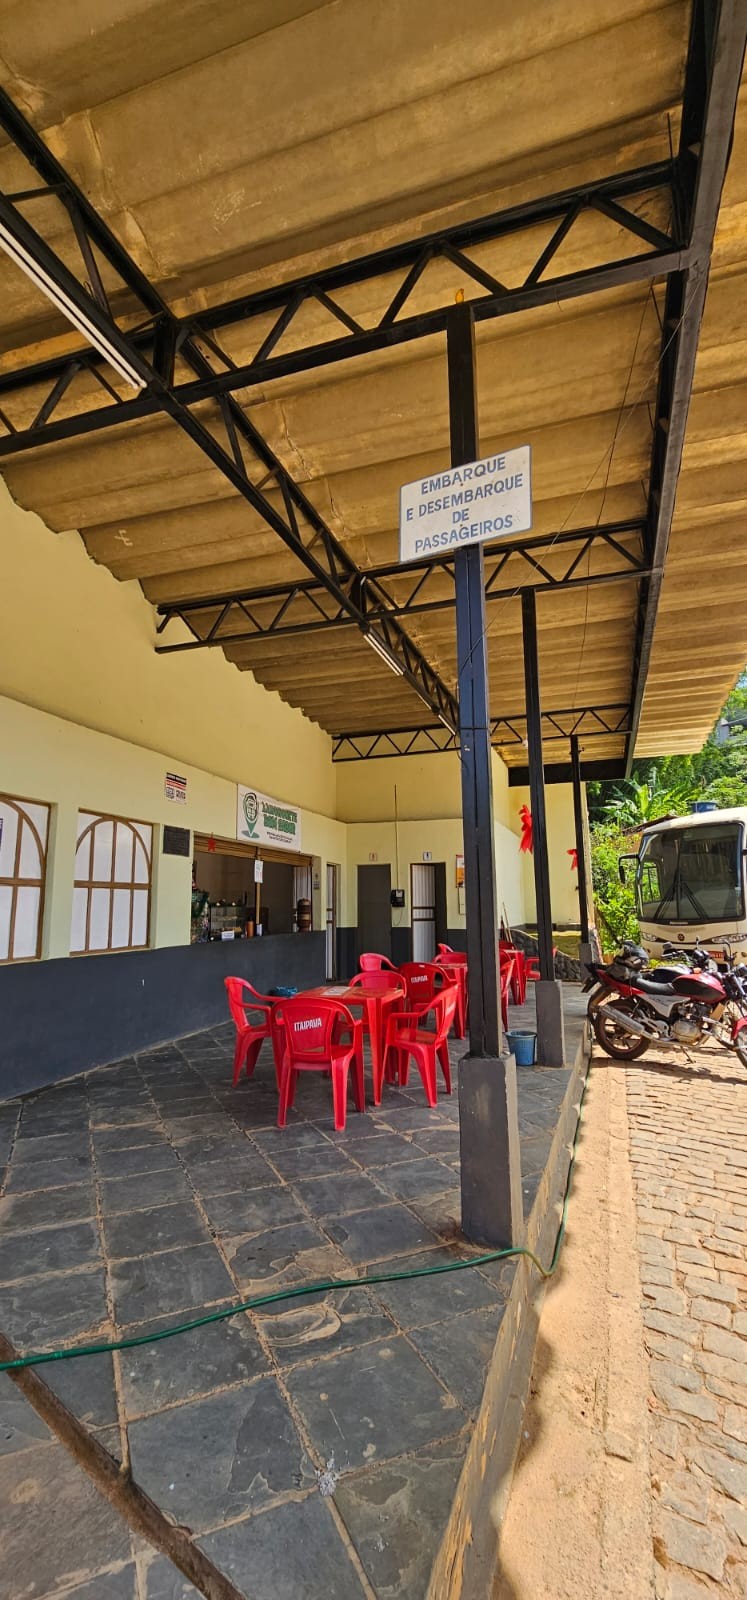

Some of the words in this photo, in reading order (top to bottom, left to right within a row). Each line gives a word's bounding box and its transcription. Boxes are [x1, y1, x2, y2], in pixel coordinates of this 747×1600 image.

[421, 456, 506, 495] EMBARQUE
[406, 507, 414, 521] E
[418, 473, 523, 517] DESEMBARQUE
[452, 508, 470, 524] DE
[414, 514, 513, 553] PASSAGEIROS
[294, 1017, 322, 1032] ITAIPAVA
